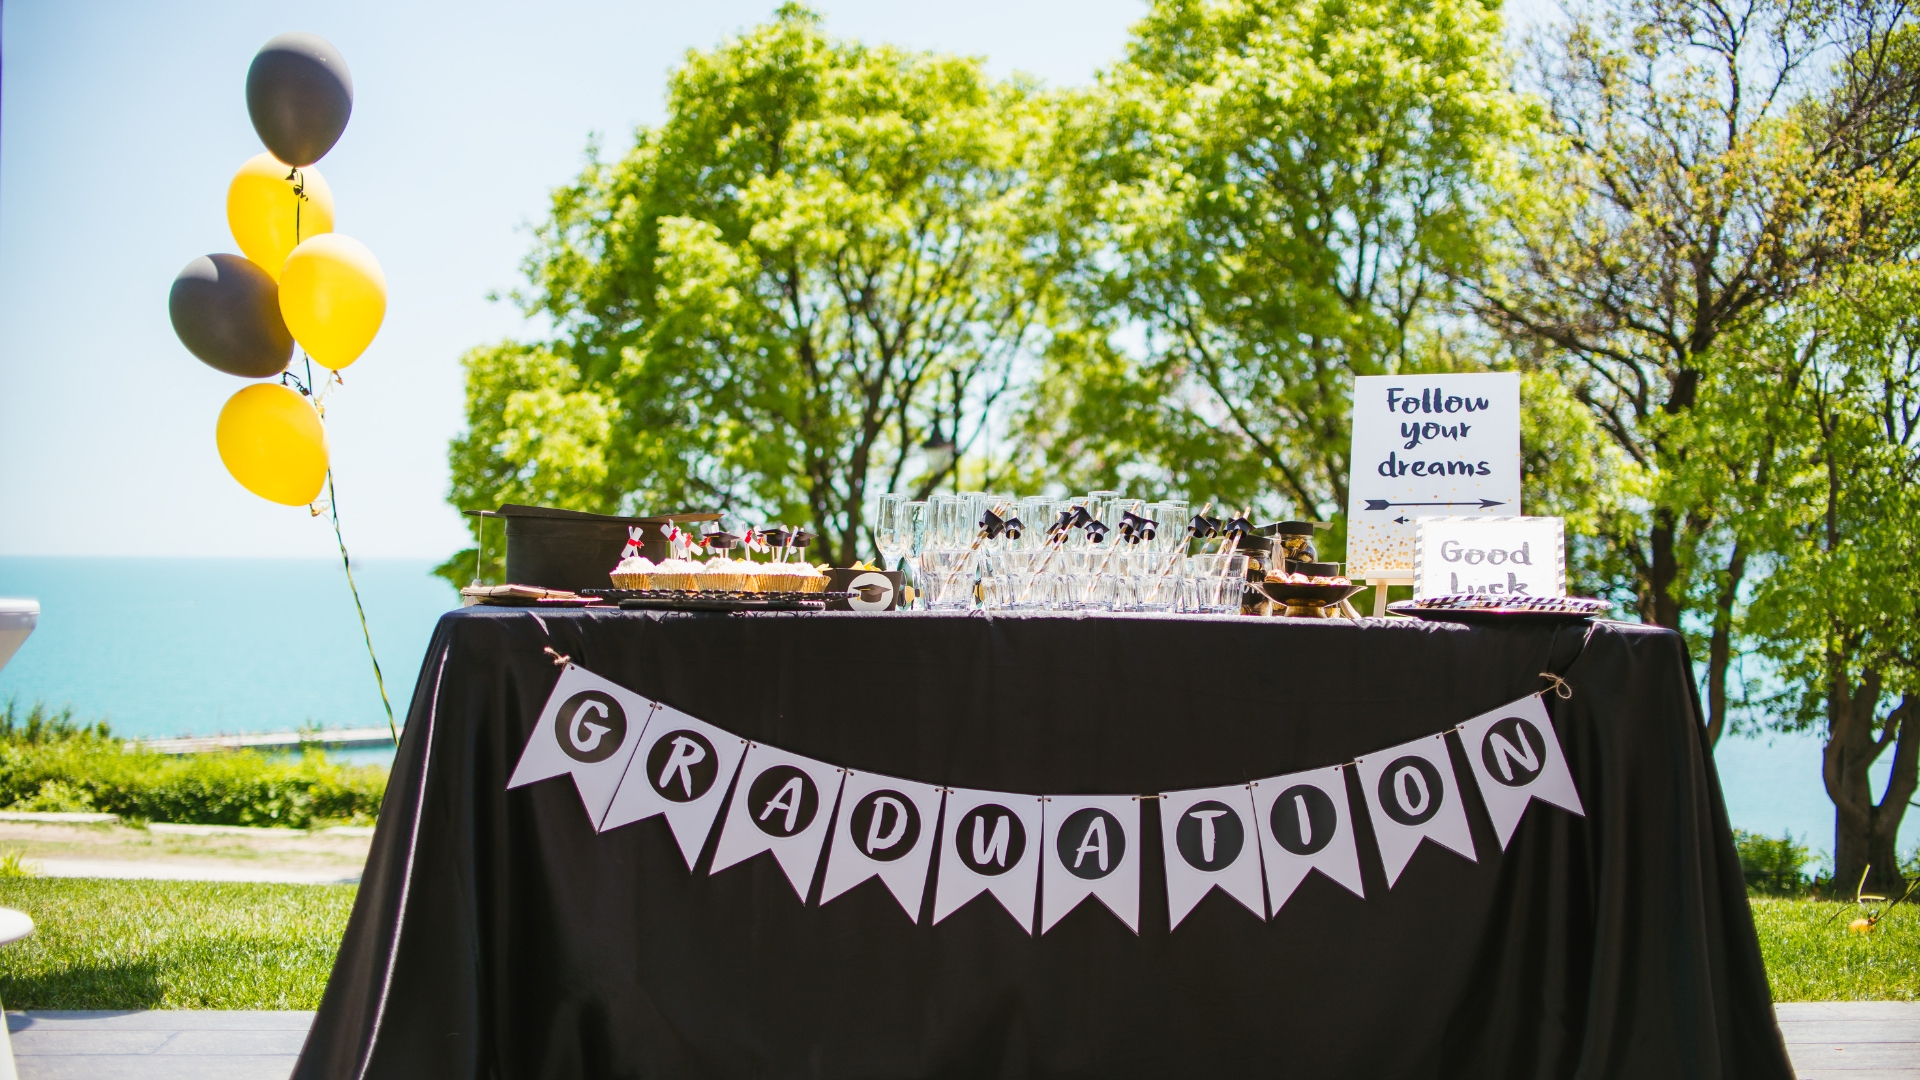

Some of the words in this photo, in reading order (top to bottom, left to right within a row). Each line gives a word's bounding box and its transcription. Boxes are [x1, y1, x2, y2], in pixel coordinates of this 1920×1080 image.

[1387, 387, 1489, 414] Follow
[1401, 421, 1472, 450] your
[1378, 451, 1491, 477] dreams
[1441, 540, 1533, 565] Good
[1450, 572, 1530, 596] Luck
[569, 699, 1539, 871] GRADUATION
